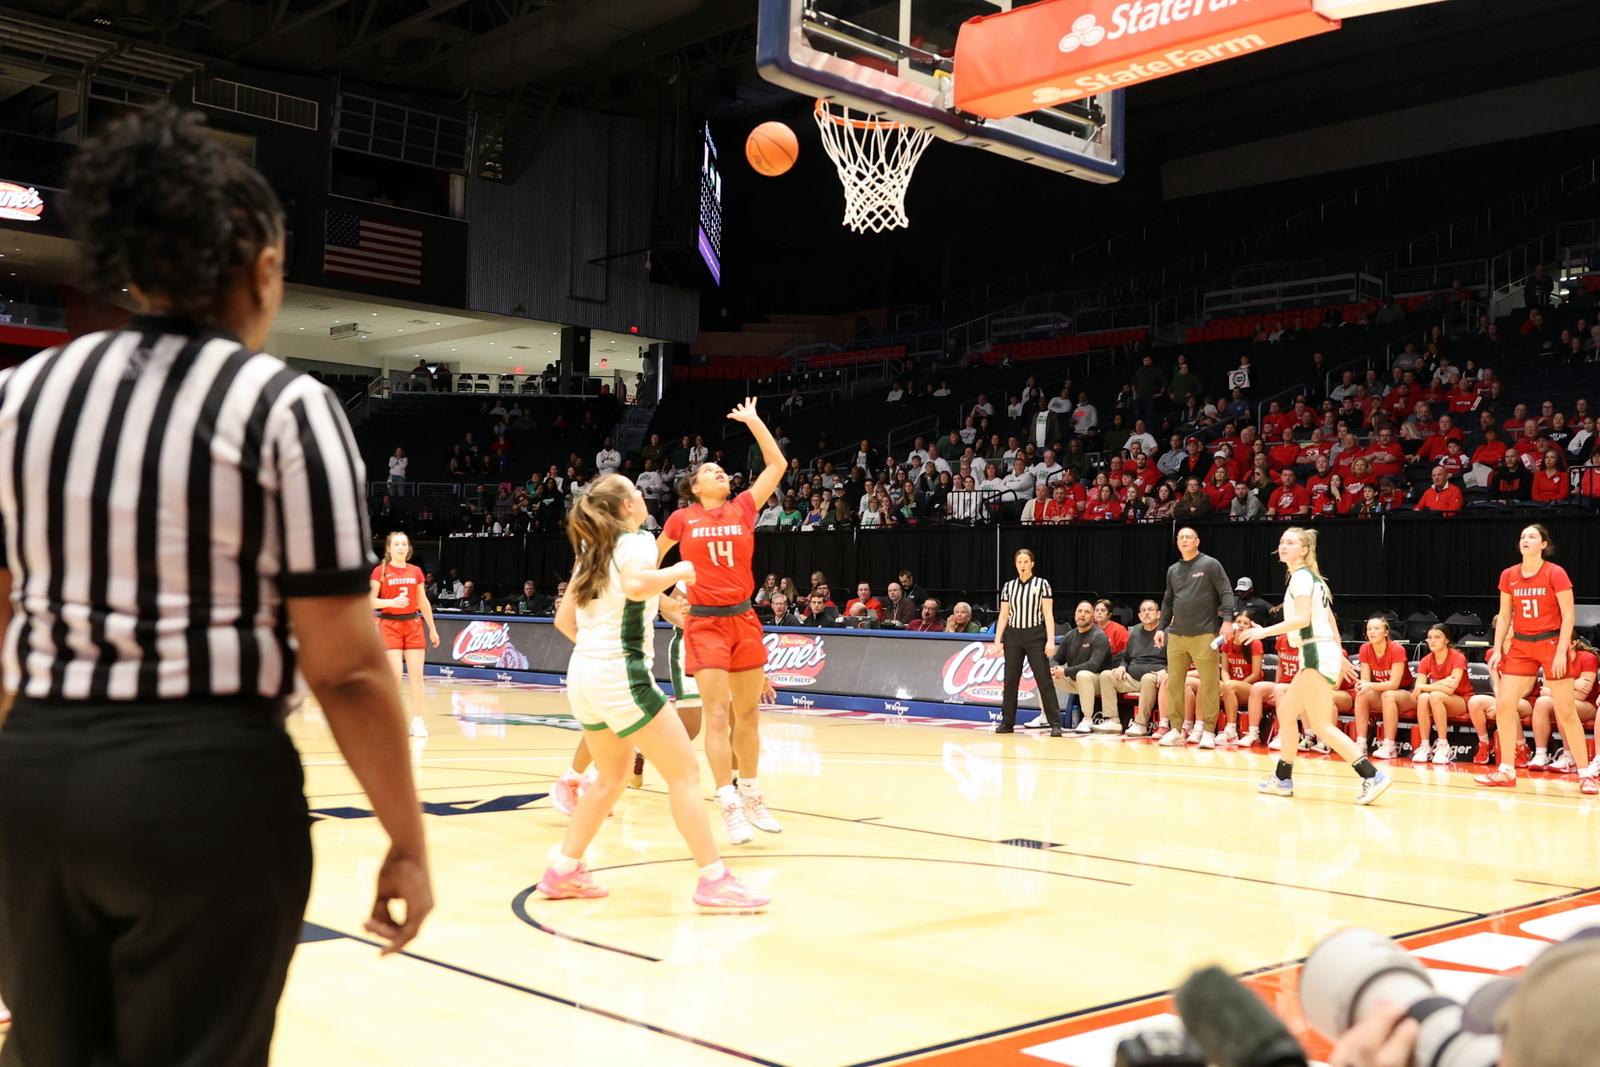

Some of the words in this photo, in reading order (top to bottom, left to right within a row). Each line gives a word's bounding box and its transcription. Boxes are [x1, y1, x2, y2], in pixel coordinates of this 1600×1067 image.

[691, 525, 743, 538] BELLEVUE
[707, 541, 734, 567] 14
[1513, 587, 1546, 597] BELLEVUE
[1521, 599, 1539, 618] 21
[452, 620, 510, 660] Cane's
[779, 636, 807, 648] Raising
[972, 688, 998, 696] CHICKEN
